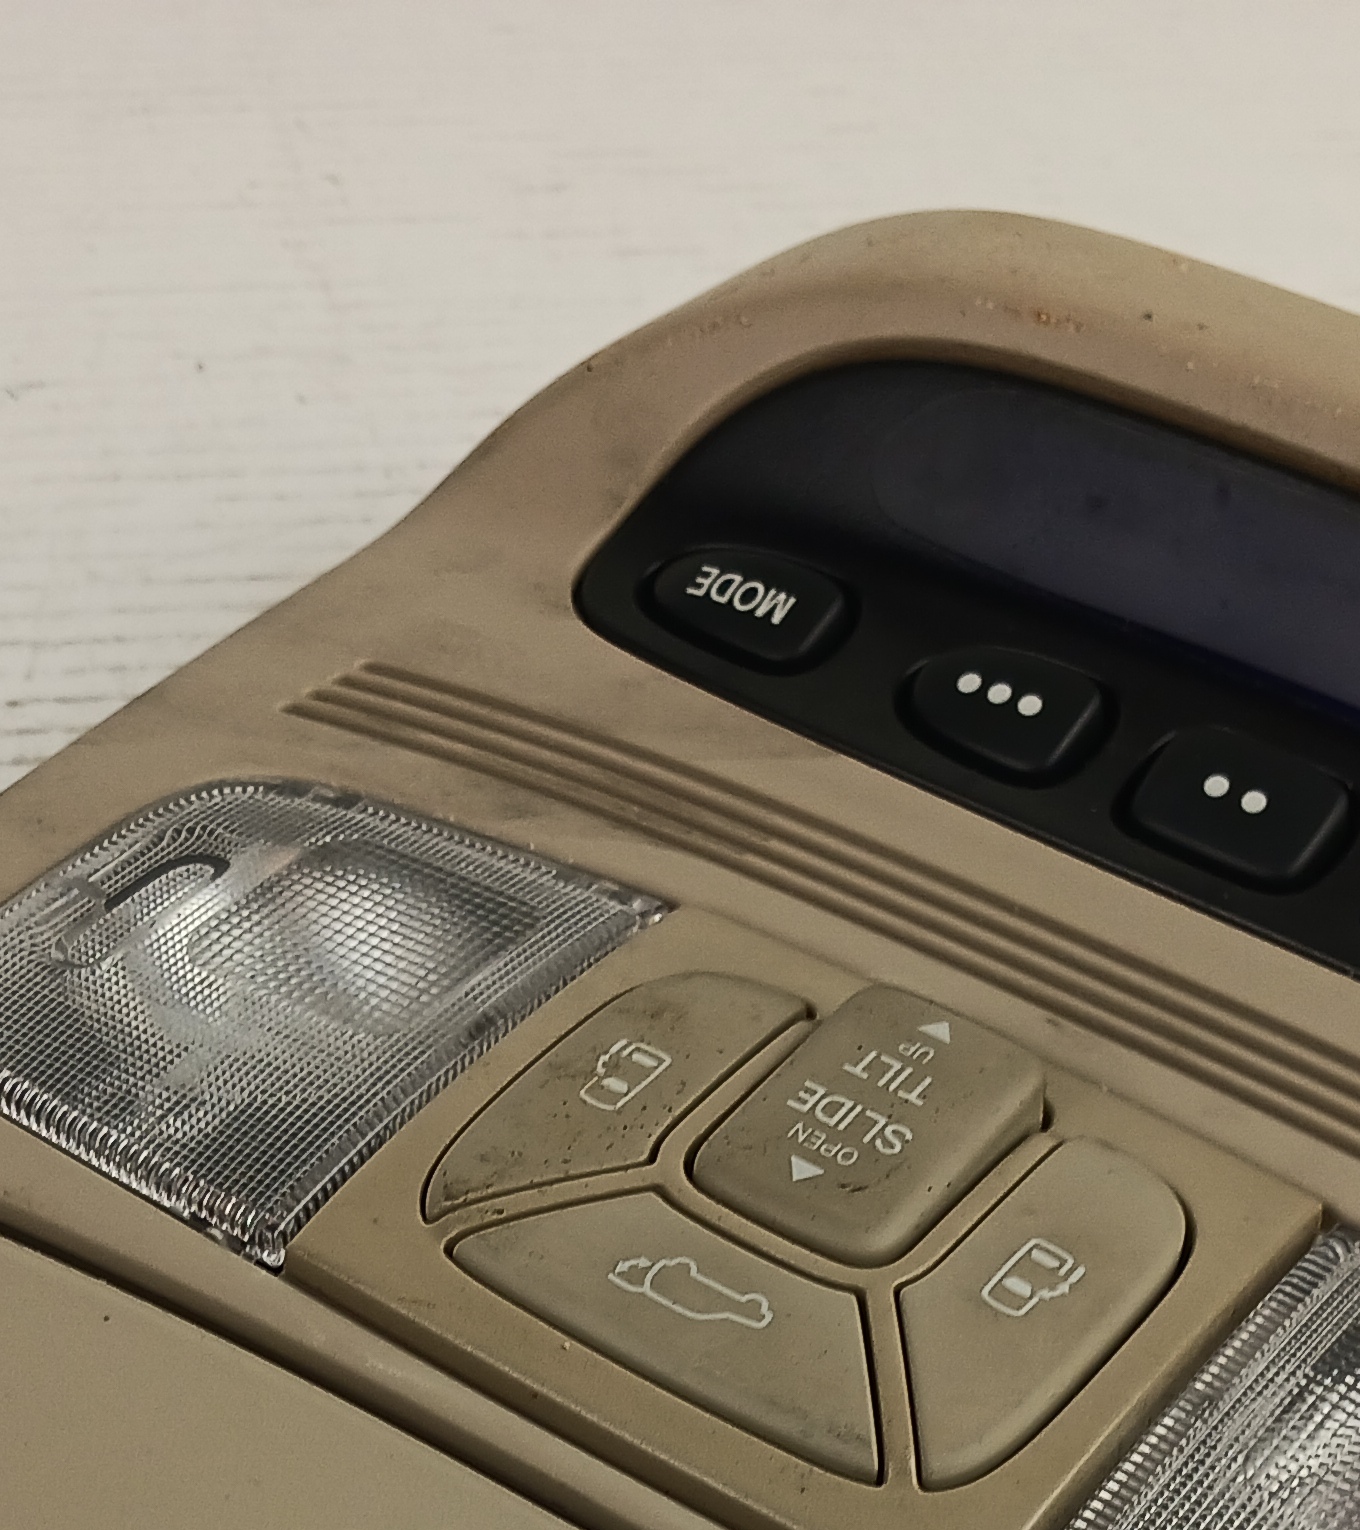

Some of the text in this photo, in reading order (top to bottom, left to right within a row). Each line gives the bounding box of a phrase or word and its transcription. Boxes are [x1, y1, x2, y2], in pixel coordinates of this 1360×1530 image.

[685, 565, 797, 625] MODE
[843, 1050, 933, 1107] TILT
[898, 1042, 935, 1065] UP
[787, 1079, 914, 1155] SLIDE
[787, 1121, 859, 1166] OPEN
